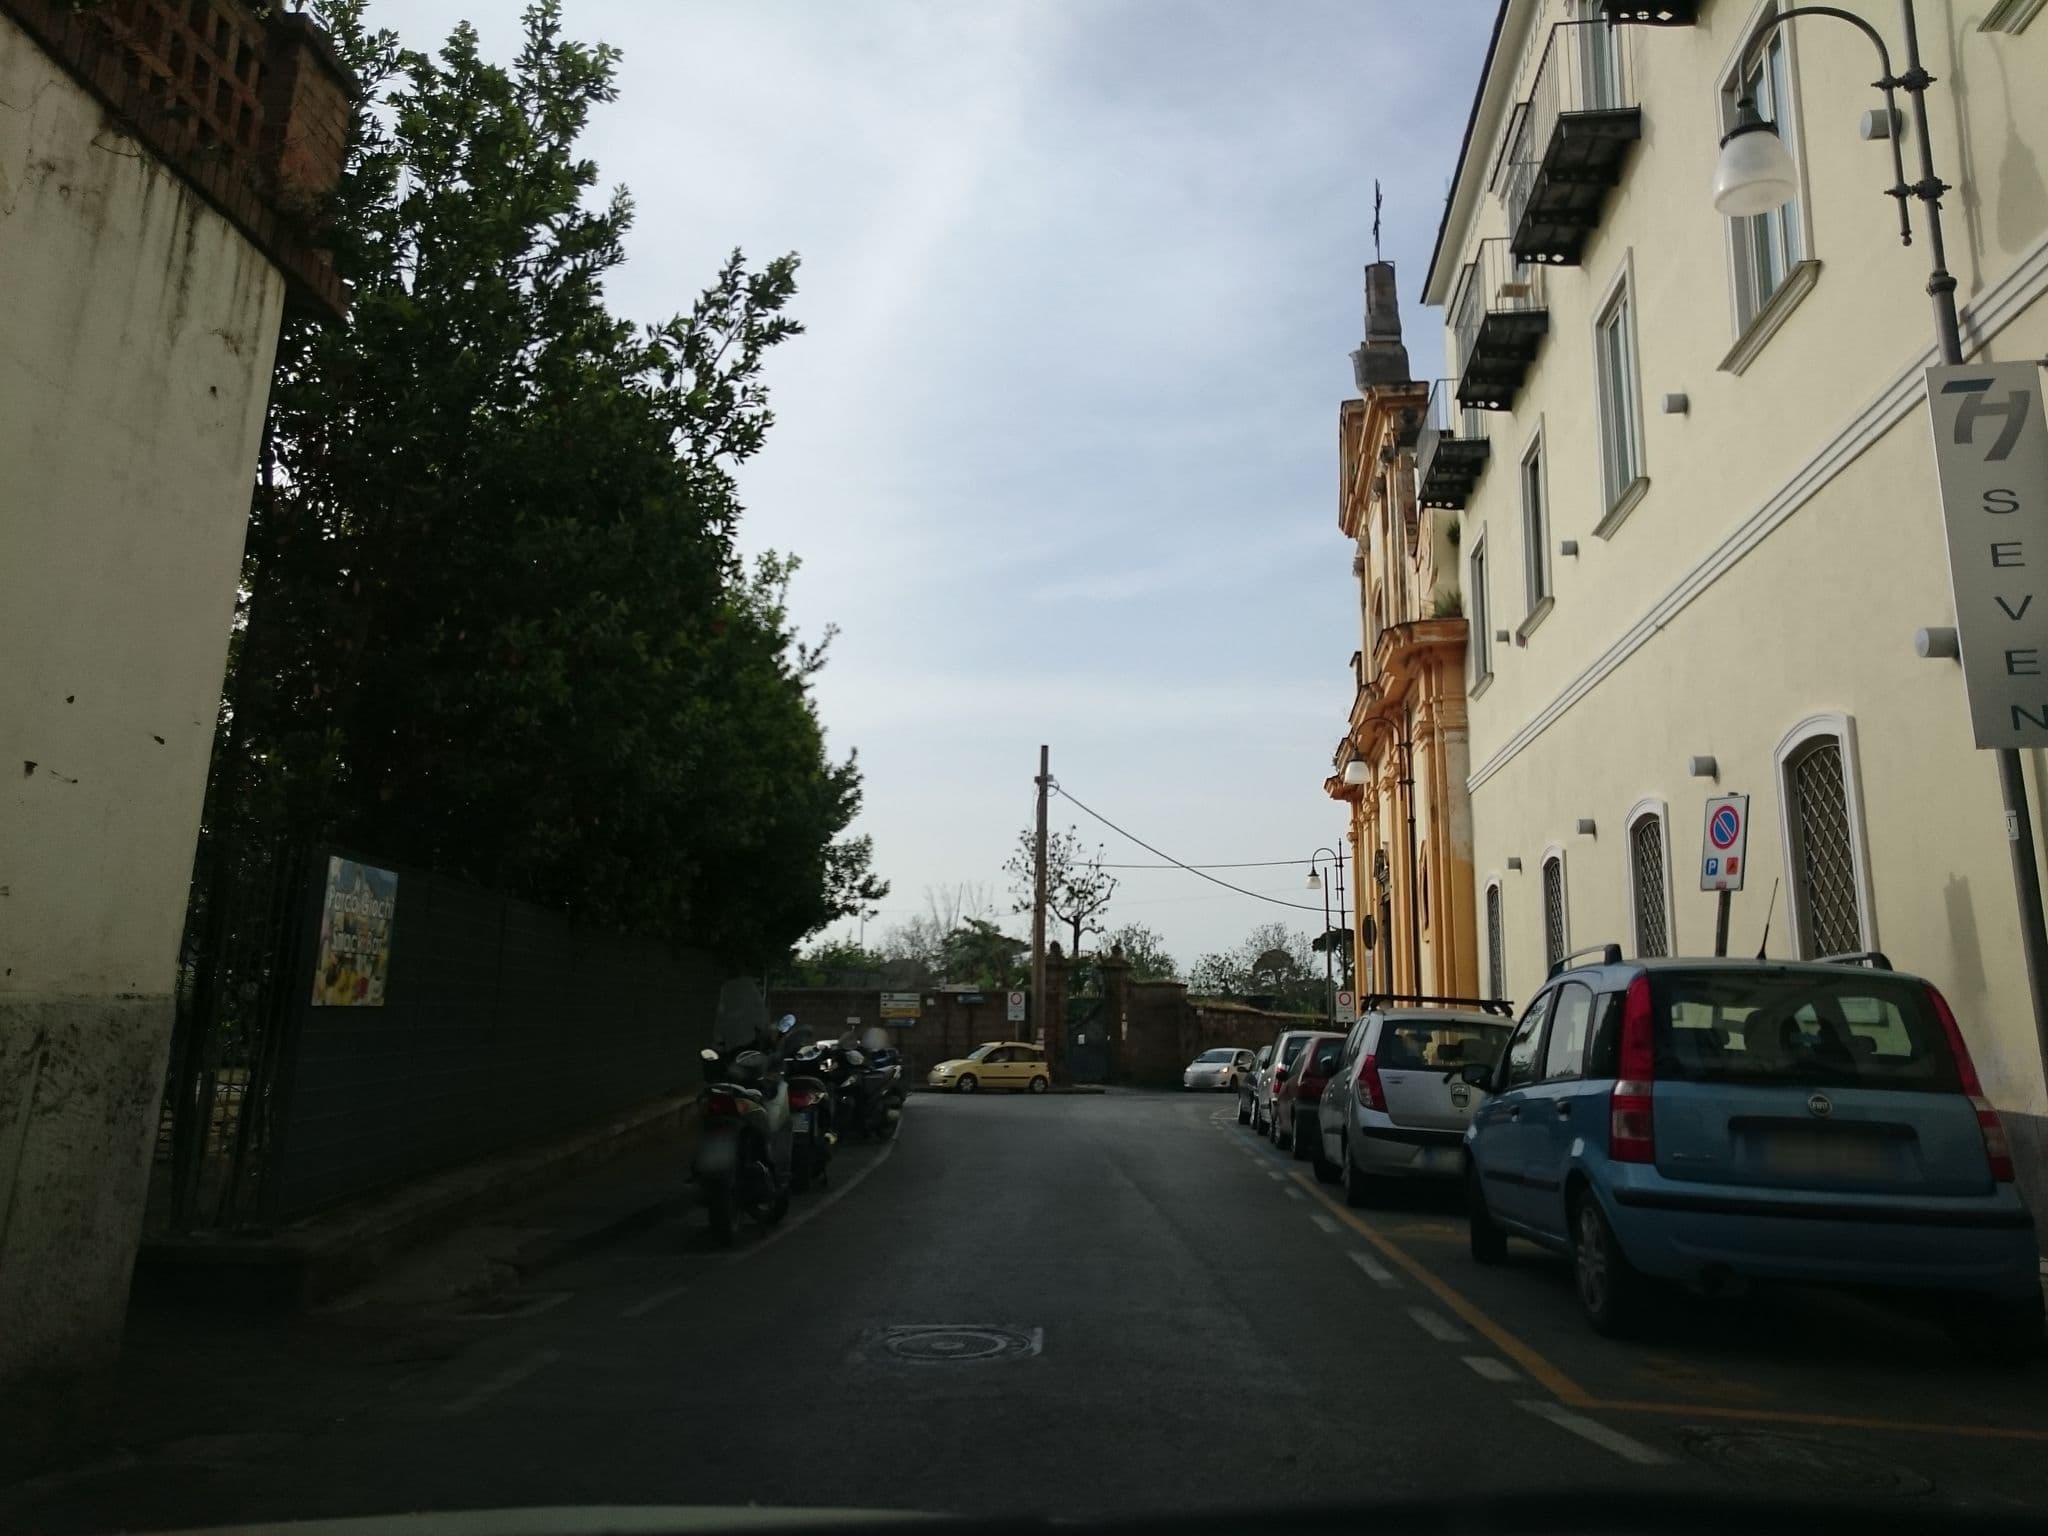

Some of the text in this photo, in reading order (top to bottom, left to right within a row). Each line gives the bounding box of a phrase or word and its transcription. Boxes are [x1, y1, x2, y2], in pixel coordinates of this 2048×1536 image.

[1983, 488, 2048, 732] SEVEN
[328, 884, 395, 920] Parco Giochi
[331, 927, 364, 953] Snack
